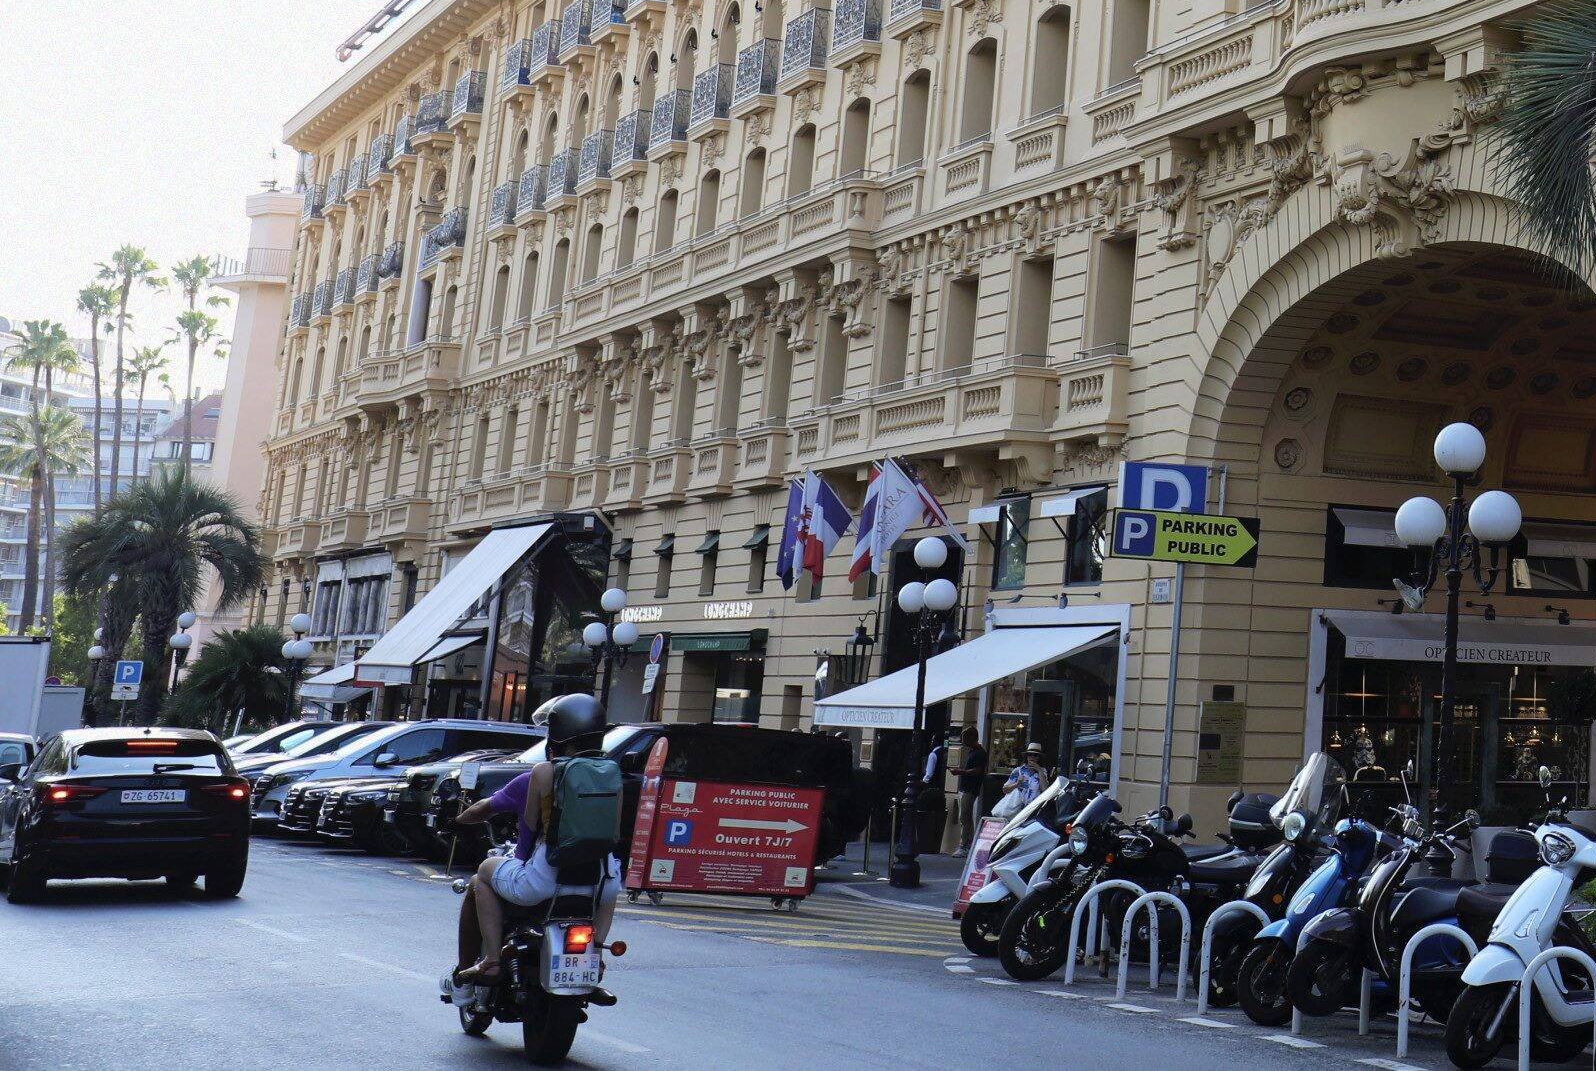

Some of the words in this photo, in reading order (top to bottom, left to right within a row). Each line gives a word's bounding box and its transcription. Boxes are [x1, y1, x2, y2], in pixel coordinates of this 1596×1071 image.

[1122, 516, 1149, 549] P
[1162, 519, 1238, 537] PARKING
[1167, 540, 1226, 557] PUBLIC
[703, 601, 753, 619] LONGCHAMP
[1488, 648, 1552, 663] CREATEUR
[122, 665, 135, 680] P
[147, 791, 176, 801] 65741
[729, 788, 767, 798] PARKING
[769, 791, 796, 800] PUBLIC
[712, 796, 734, 805] AVEC
[735, 798, 768, 807] SERVICE
[769, 800, 809, 810] VOITURIER
[669, 822, 688, 842] P
[715, 833, 760, 846] Ouvert
[765, 835, 793, 847] 7J/7
[668, 847, 697, 855] PARKING
[755, 851, 797, 860] RESTAURANTS
